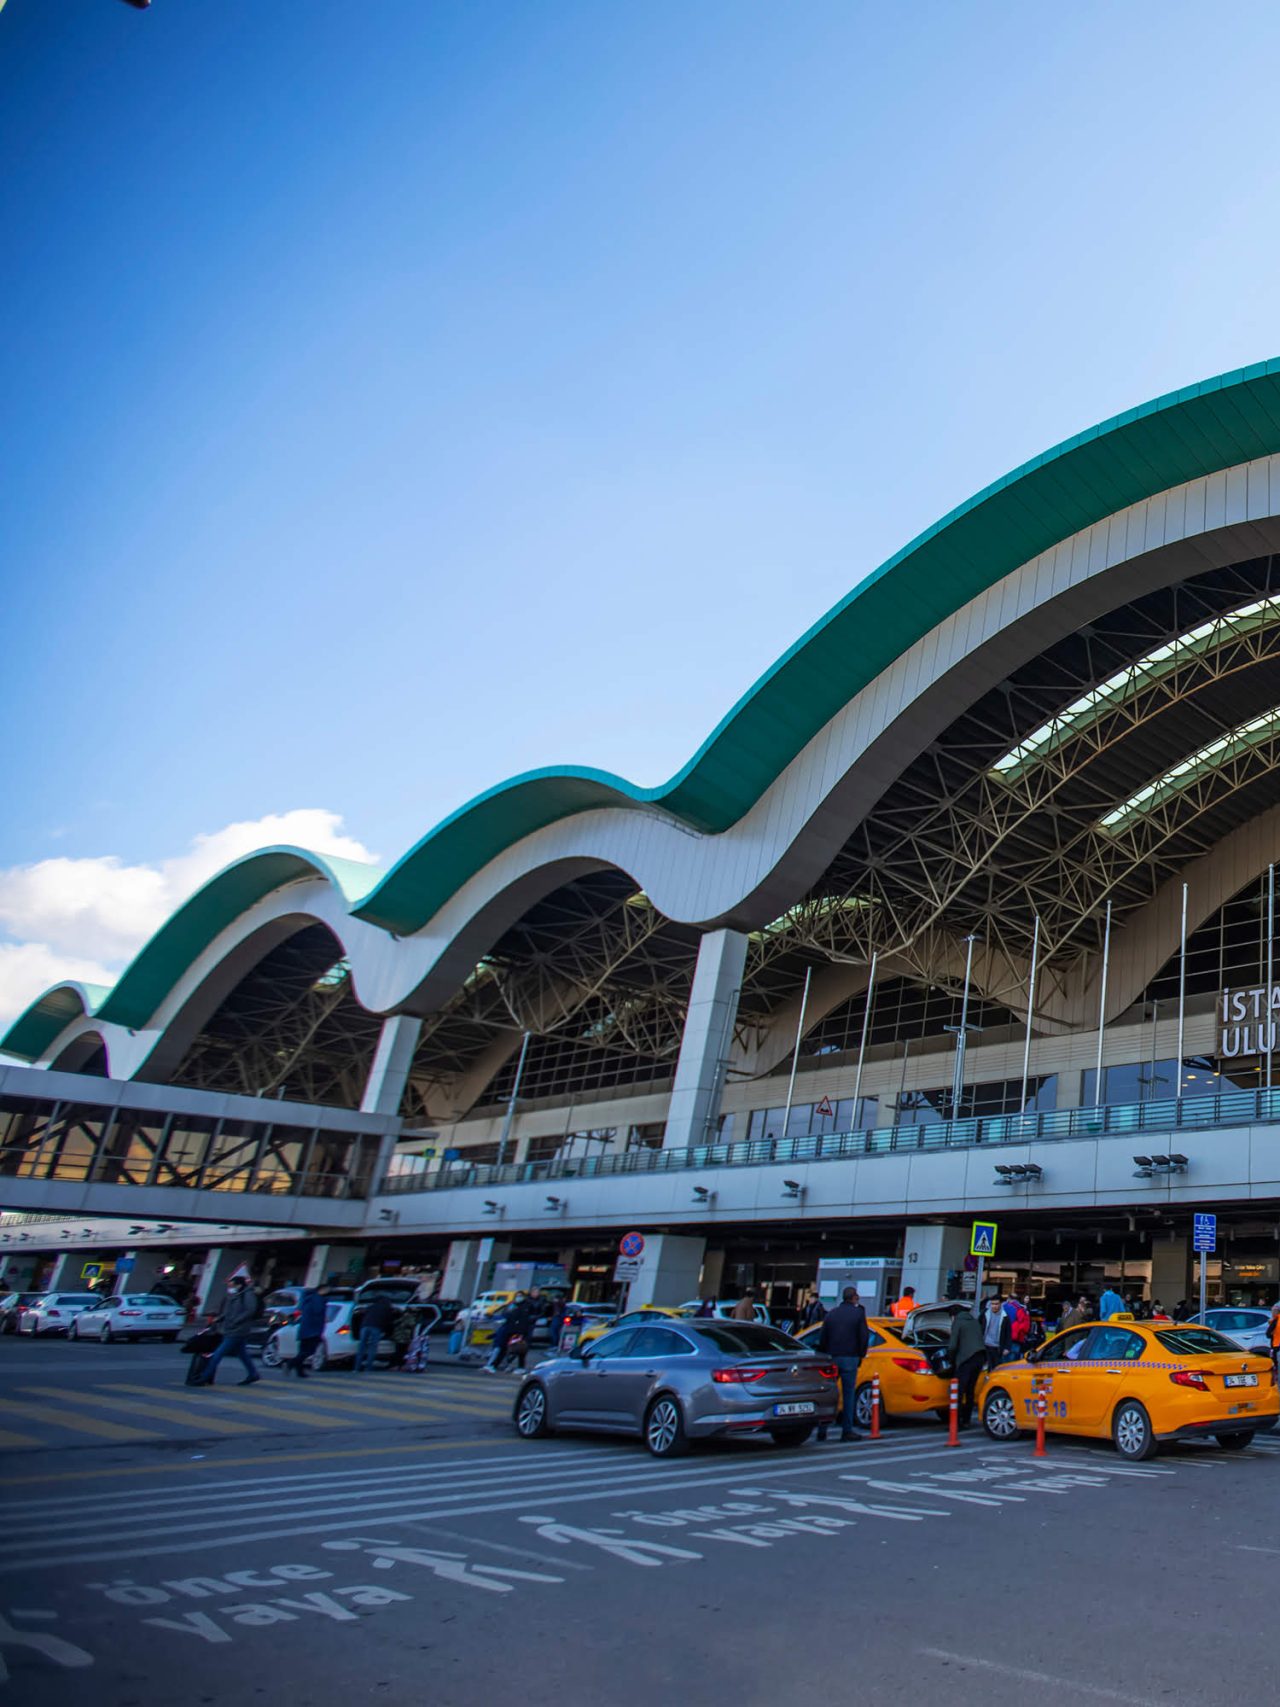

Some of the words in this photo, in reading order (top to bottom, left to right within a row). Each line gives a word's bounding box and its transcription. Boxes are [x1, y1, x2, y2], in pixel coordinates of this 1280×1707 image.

[908, 1252, 918, 1264] 13
[1053, 1401, 1067, 1418] 18
[610, 1502, 777, 1527] önce
[688, 1515, 858, 1547] yaya
[85, 1563, 336, 1605] önce
[140, 1583, 415, 1643] yaya
